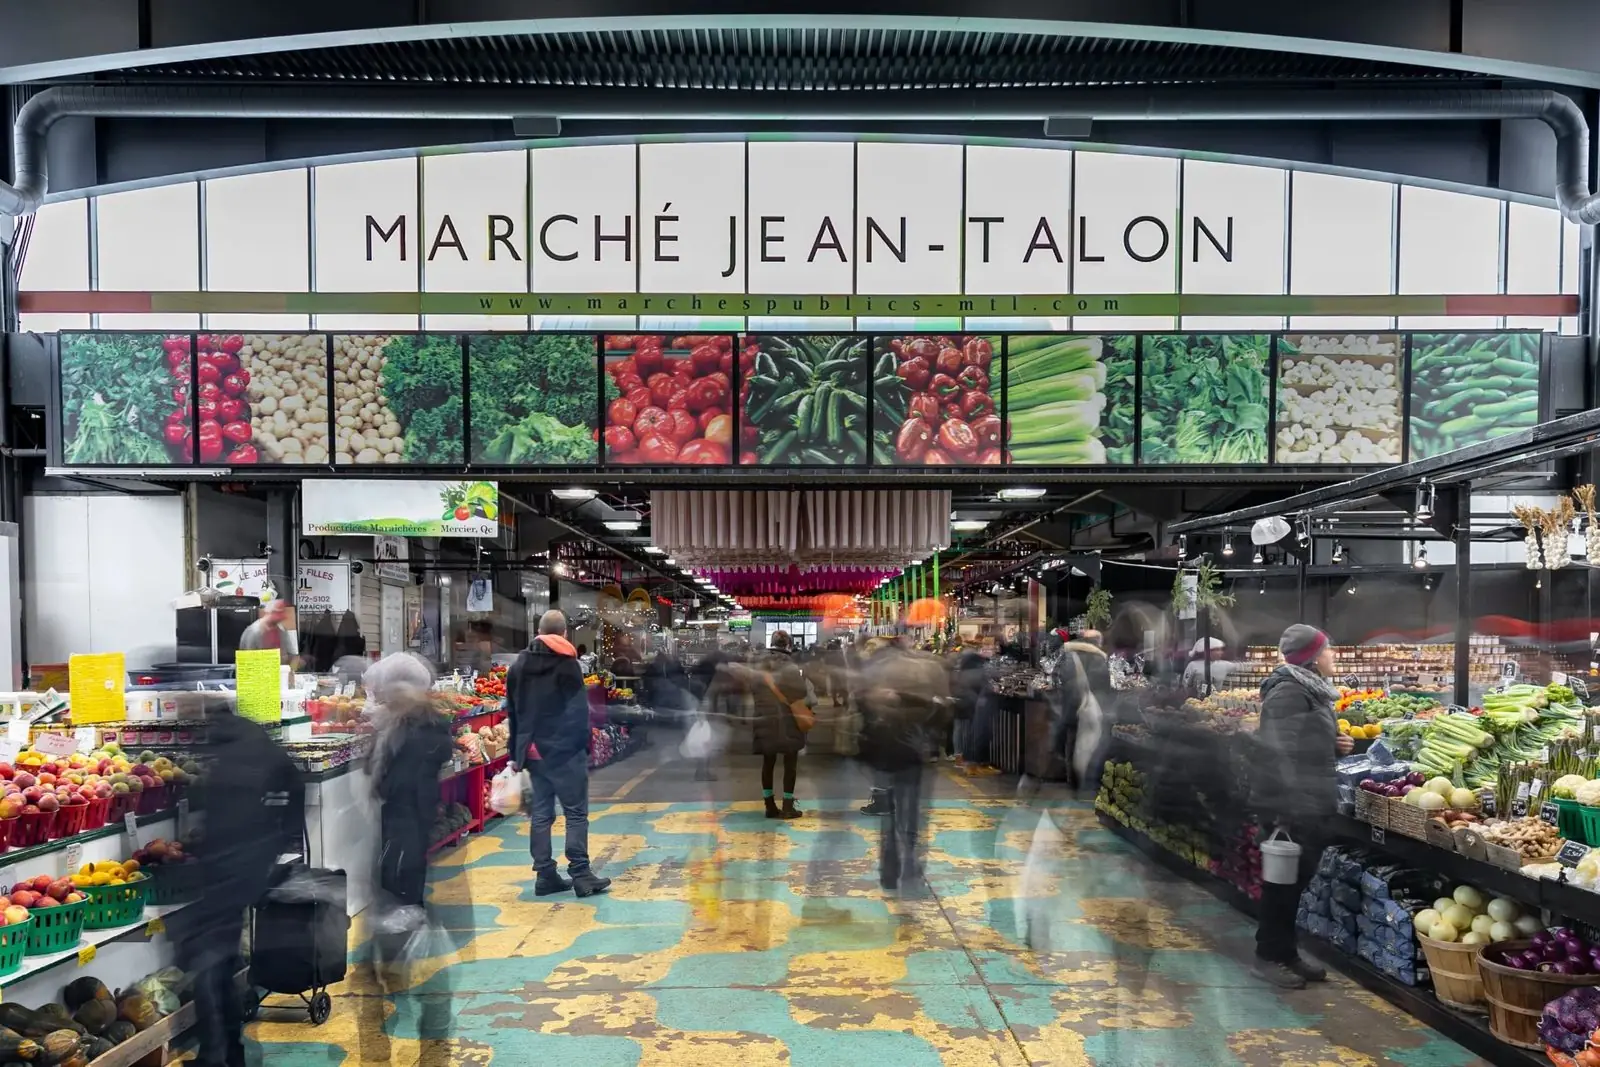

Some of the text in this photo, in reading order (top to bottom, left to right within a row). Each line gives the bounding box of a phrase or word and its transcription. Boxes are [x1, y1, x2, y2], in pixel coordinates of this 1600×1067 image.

[365, 202, 1233, 278] MARCHÉ JEAN-TALON
[479, 295, 1119, 314] www.marchespublics-mtl.com
[308, 523, 368, 532] Productrices
[440, 524, 478, 534] Mercier,
[480, 524, 493, 534] Qc
[307, 569, 333, 580] FILLES
